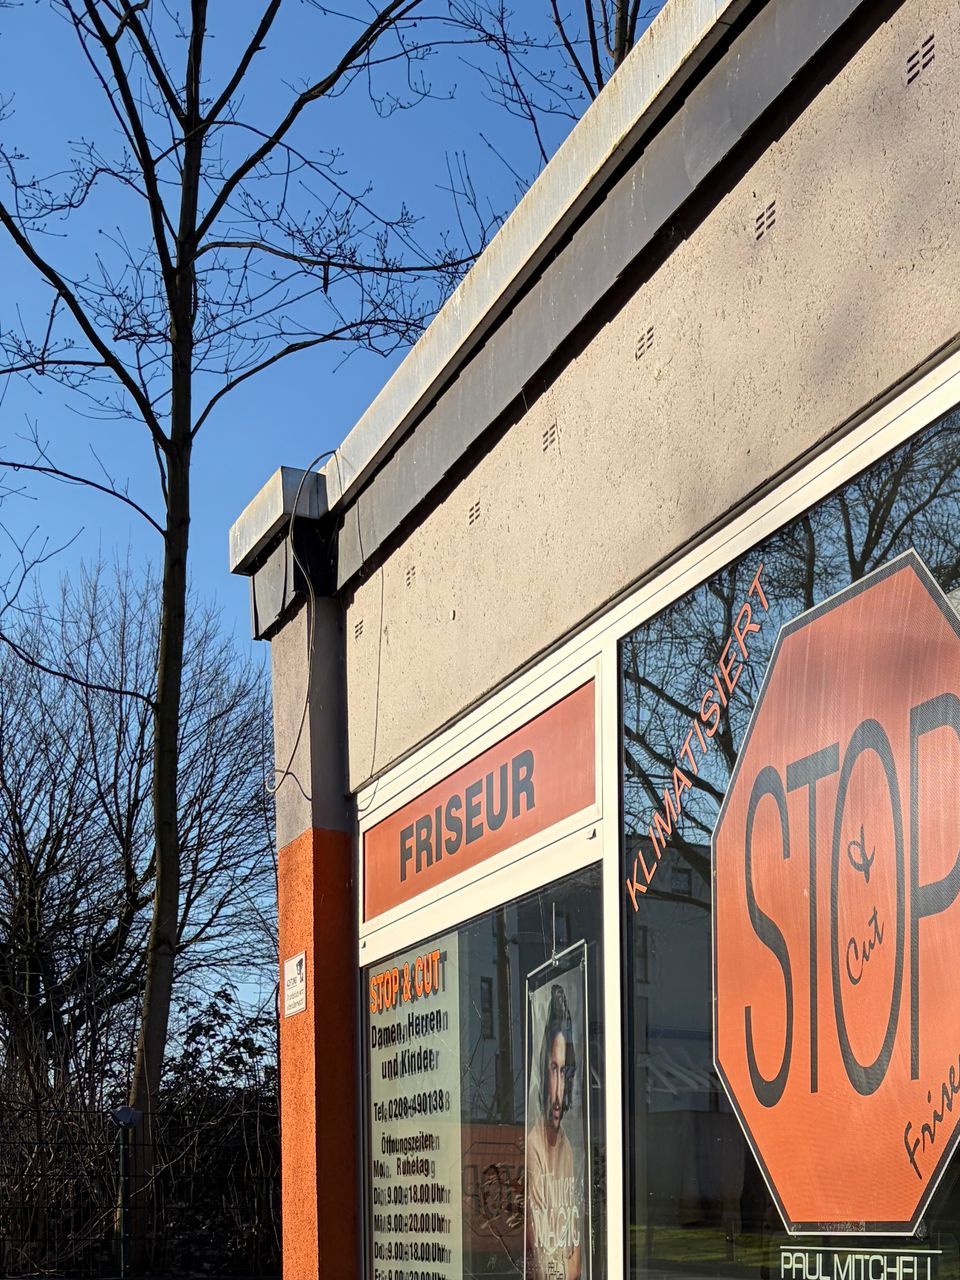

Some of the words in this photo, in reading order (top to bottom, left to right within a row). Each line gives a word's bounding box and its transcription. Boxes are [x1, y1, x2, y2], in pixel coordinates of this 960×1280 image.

[625, 563, 774, 914] KLIMATISIERT
[400, 749, 536, 882] FRISEUR
[847, 824, 876, 885] &
[845, 906, 886, 987] Cut
[370, 966, 399, 1014] STOP
[403, 961, 412, 1002] &
[415, 949, 440, 997] CUT
[371, 1021, 405, 1049] Damen,
[408, 1008, 442, 1039] Herren
[382, 1052, 399, 1080] und
[401, 1046, 433, 1076] Kinder
[388, 1088, 444, 1118] 0208-490138
[381, 1131, 434, 1156] Öffnungszeiten
[396, 1156, 429, 1178] Ruhetag
[431, 1183, 445, 1204] Uhr
[431, 1213, 445, 1233] Uhr
[432, 1242, 445, 1263] Uhr
[779, 1252, 830, 1280] PAUL
